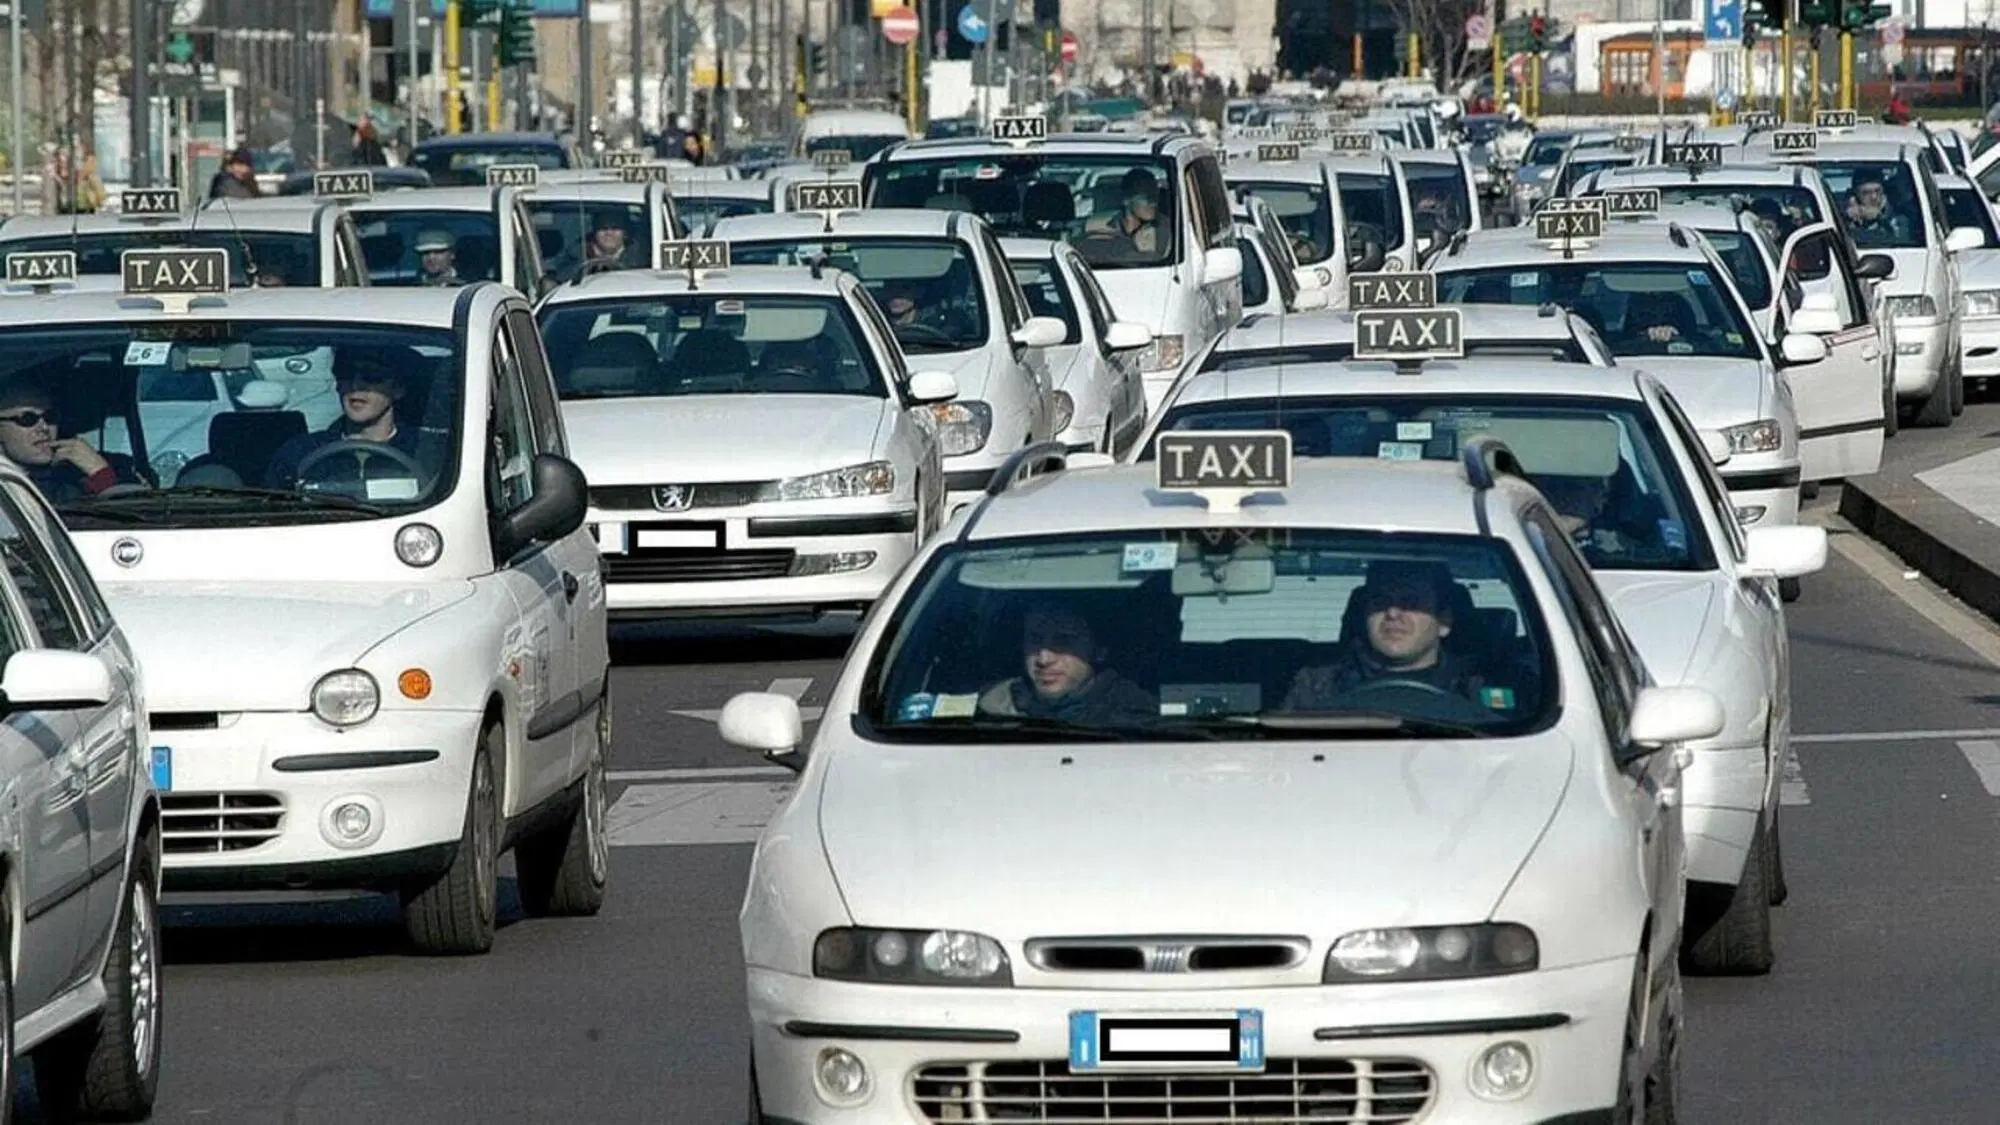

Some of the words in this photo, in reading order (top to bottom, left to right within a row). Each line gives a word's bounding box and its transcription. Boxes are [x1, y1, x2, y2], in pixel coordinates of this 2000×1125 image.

[1819, 114, 1853, 125] TAXI
[995, 121, 1042, 137] TAXI
[1335, 138, 1371, 149] TAXI
[1776, 134, 1814, 148] TAXI
[1260, 146, 1297, 160] TAXI
[1672, 148, 1717, 162] TAXI
[491, 171, 533, 183] TAXI
[625, 168, 663, 180] TAXI
[319, 177, 367, 193] TAXI
[124, 194, 175, 211] TAXI
[803, 189, 853, 206] TAXI
[1608, 194, 1655, 210] TAXI
[1539, 216, 1594, 235] TAXI
[664, 246, 721, 264] TAXI
[12, 257, 68, 277] TAXI
[129, 259, 214, 286] TAXI
[1352, 280, 1424, 304] TAXI
[1362, 318, 1453, 346] TAXI
[1166, 445, 1274, 478] TAXI
